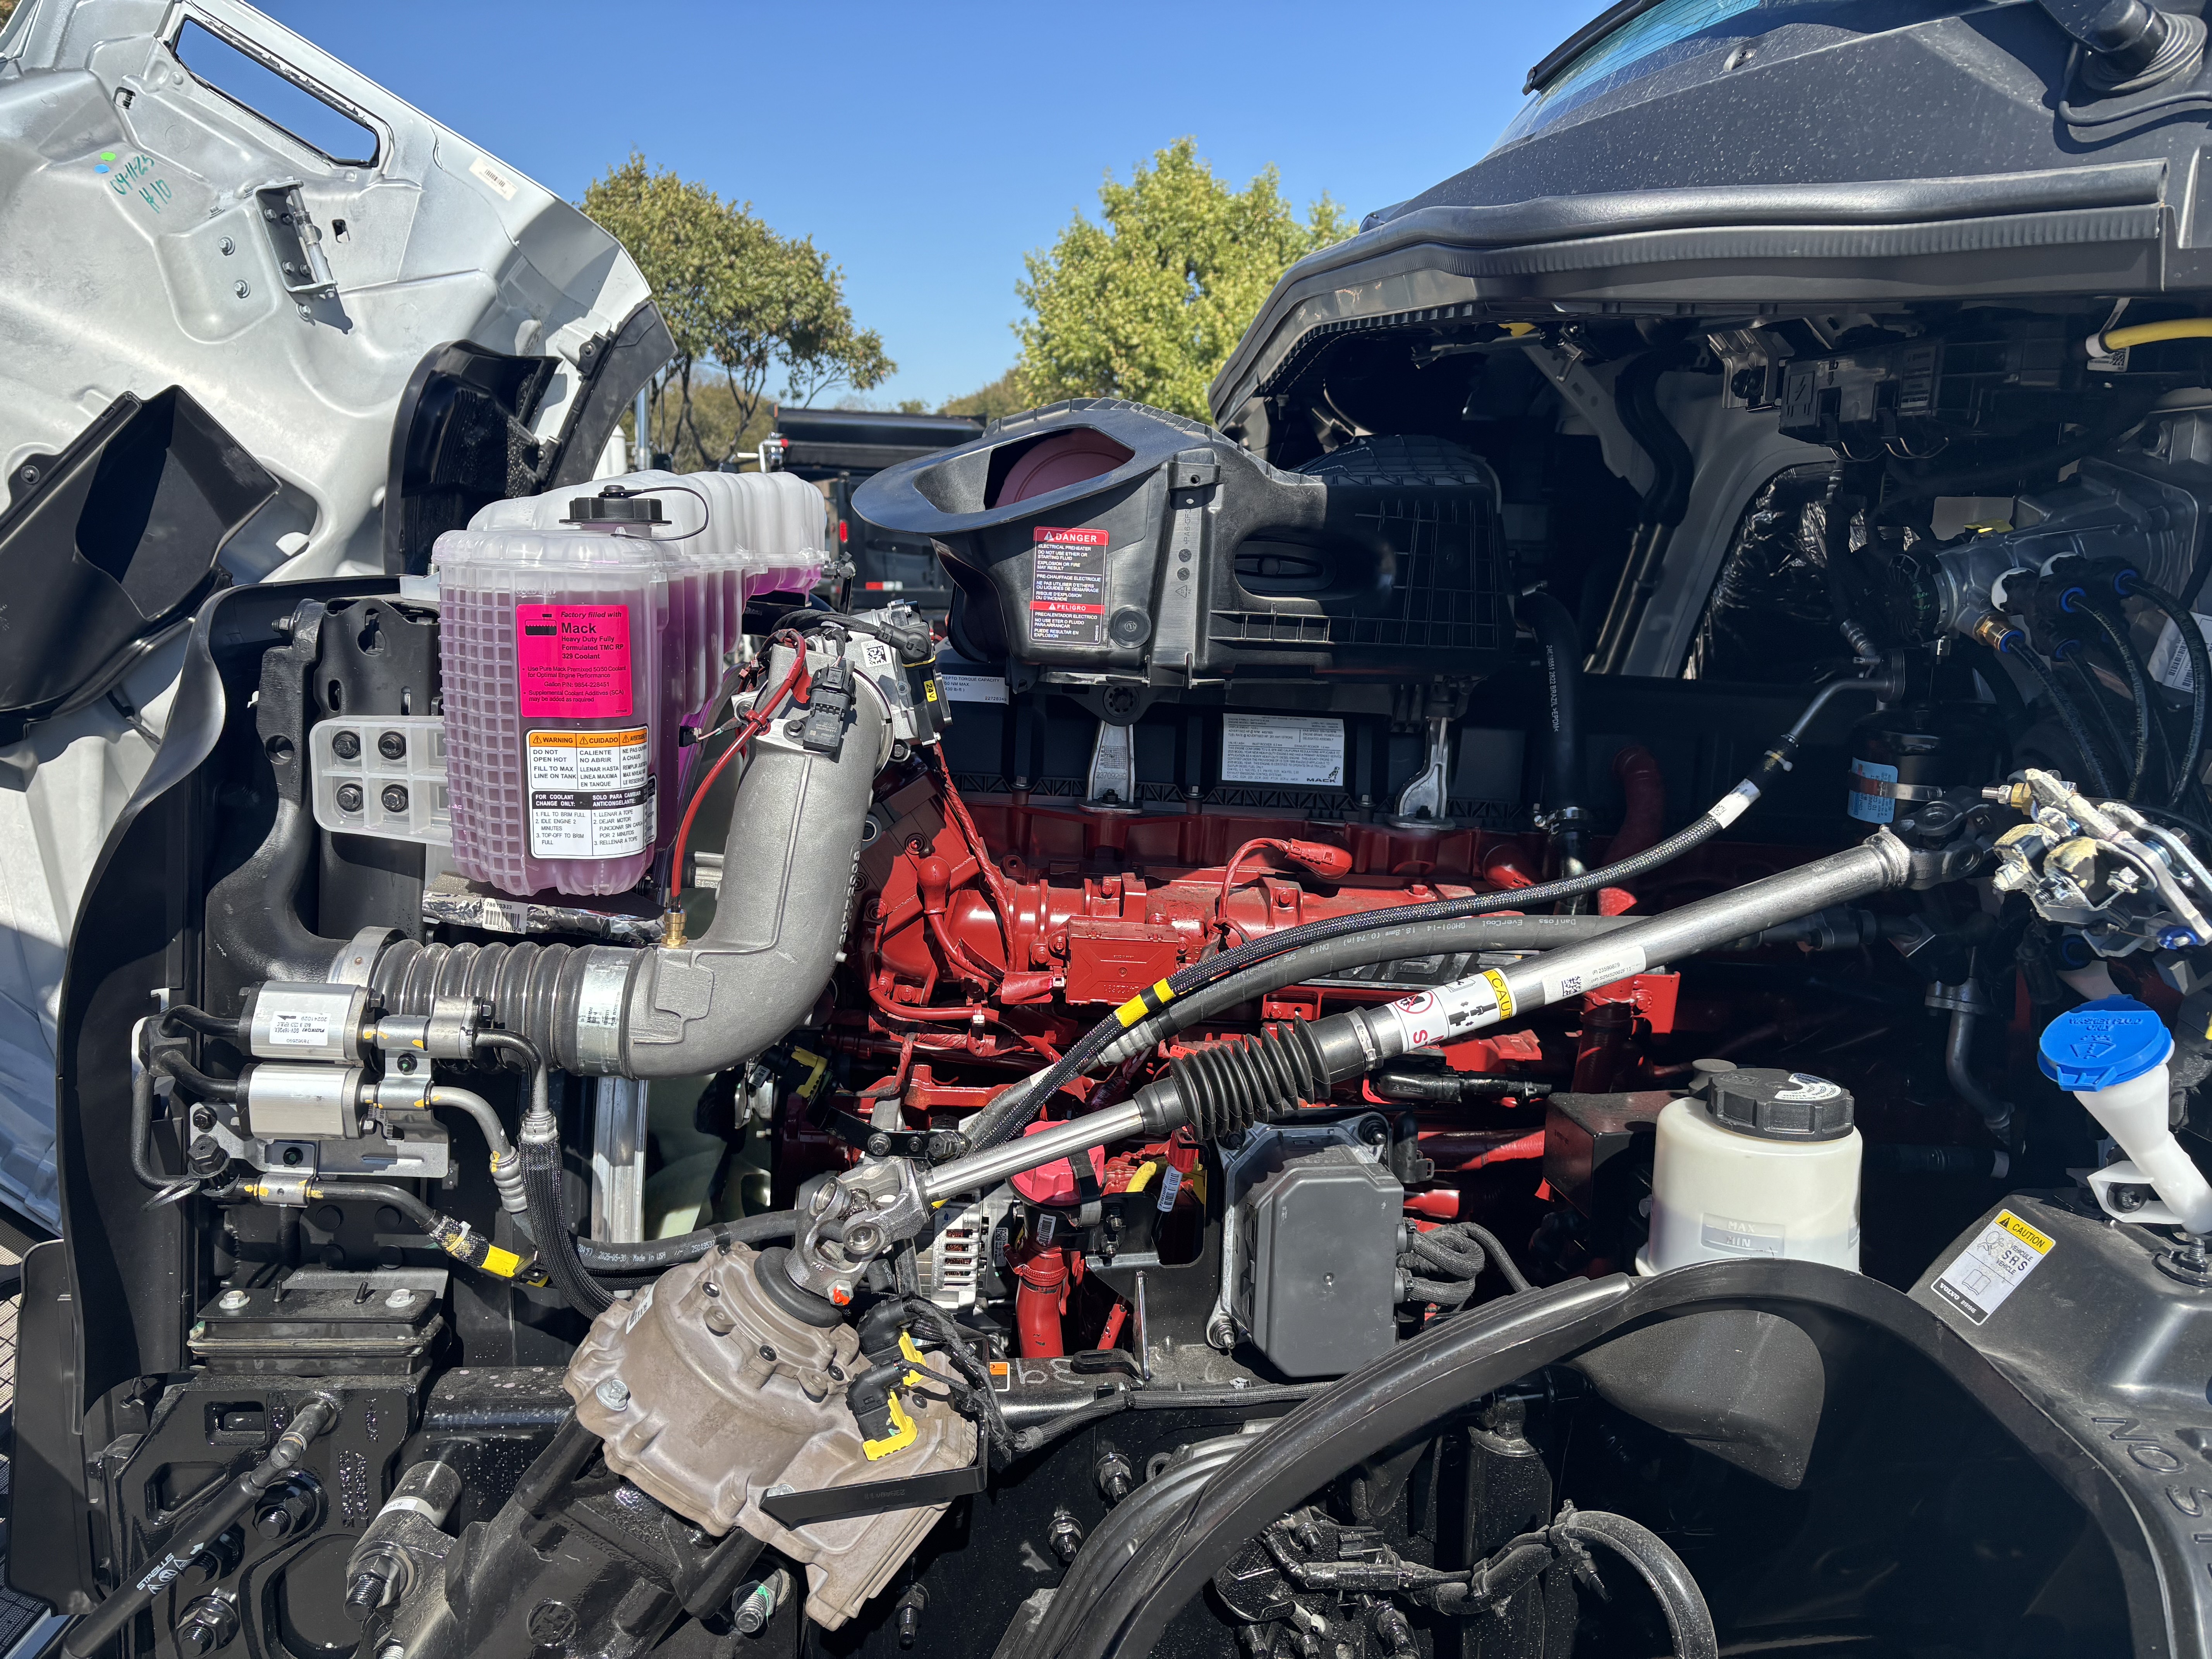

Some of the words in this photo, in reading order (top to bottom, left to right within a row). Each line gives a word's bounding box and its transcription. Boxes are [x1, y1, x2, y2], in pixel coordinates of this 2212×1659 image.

[1056, 533, 1097, 543] DANGER
[562, 623, 596, 633] Mack
[926, 684, 935, 699] 24V
[593, 799, 636, 807] ANTICONGELANTE:
[1385, 927, 1415, 936] 18.8mm
[1427, 922, 1466, 932] GH001-14
[1310, 943, 1329, 954] DN19
[1283, 953, 1296, 962] SAE
[1599, 963, 1620, 973] 23590879
[1728, 1221, 1755, 1233] MAX
[1727, 1236, 1750, 1247] MIN
[2012, 1224, 2045, 1248] CAUTION
[2011, 1244, 2033, 1262] VEHICULE
[1996, 1259, 2016, 1275] VEHICLE
[883, 1261, 893, 1285] EverCool
[1940, 1282, 1960, 1300] VOLVO
[137, 1553, 174, 1590] STABILUS
